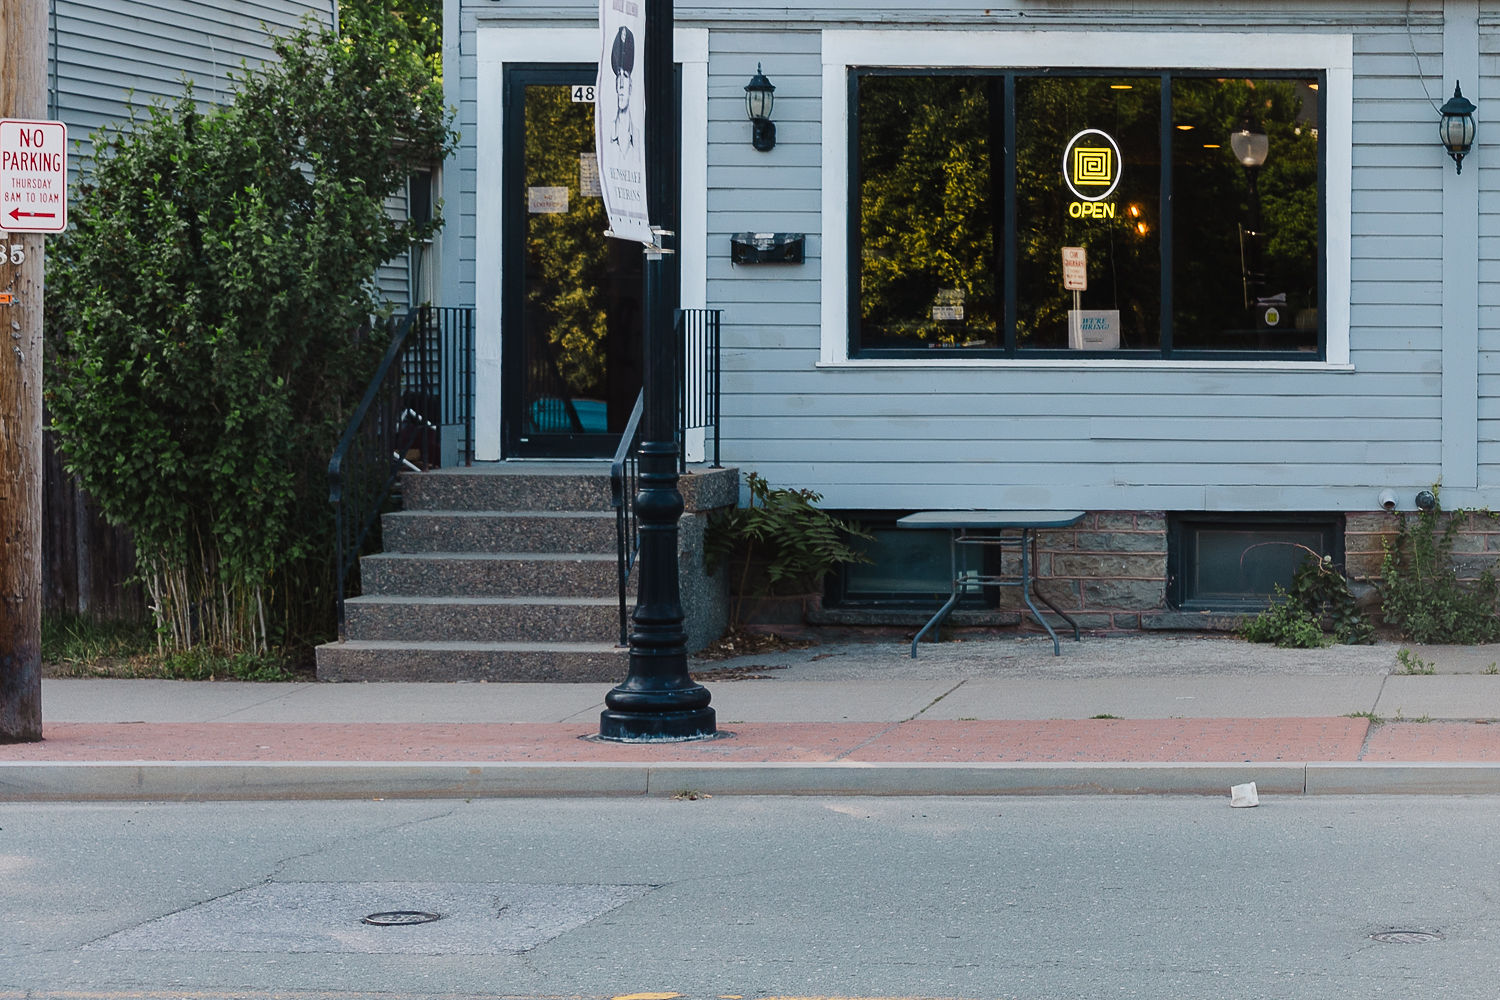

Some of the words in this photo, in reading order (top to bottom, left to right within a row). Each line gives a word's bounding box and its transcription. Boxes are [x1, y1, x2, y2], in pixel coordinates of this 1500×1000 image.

[20, 128, 44, 148] NO
[2, 151, 61, 172] PARKING
[12, 177, 52, 189] THURSDAY
[4, 191, 22, 202] 8AM
[26, 192, 36, 203] TO
[39, 192, 60, 204] 10AM
[1068, 201, 1116, 219] OPEN
